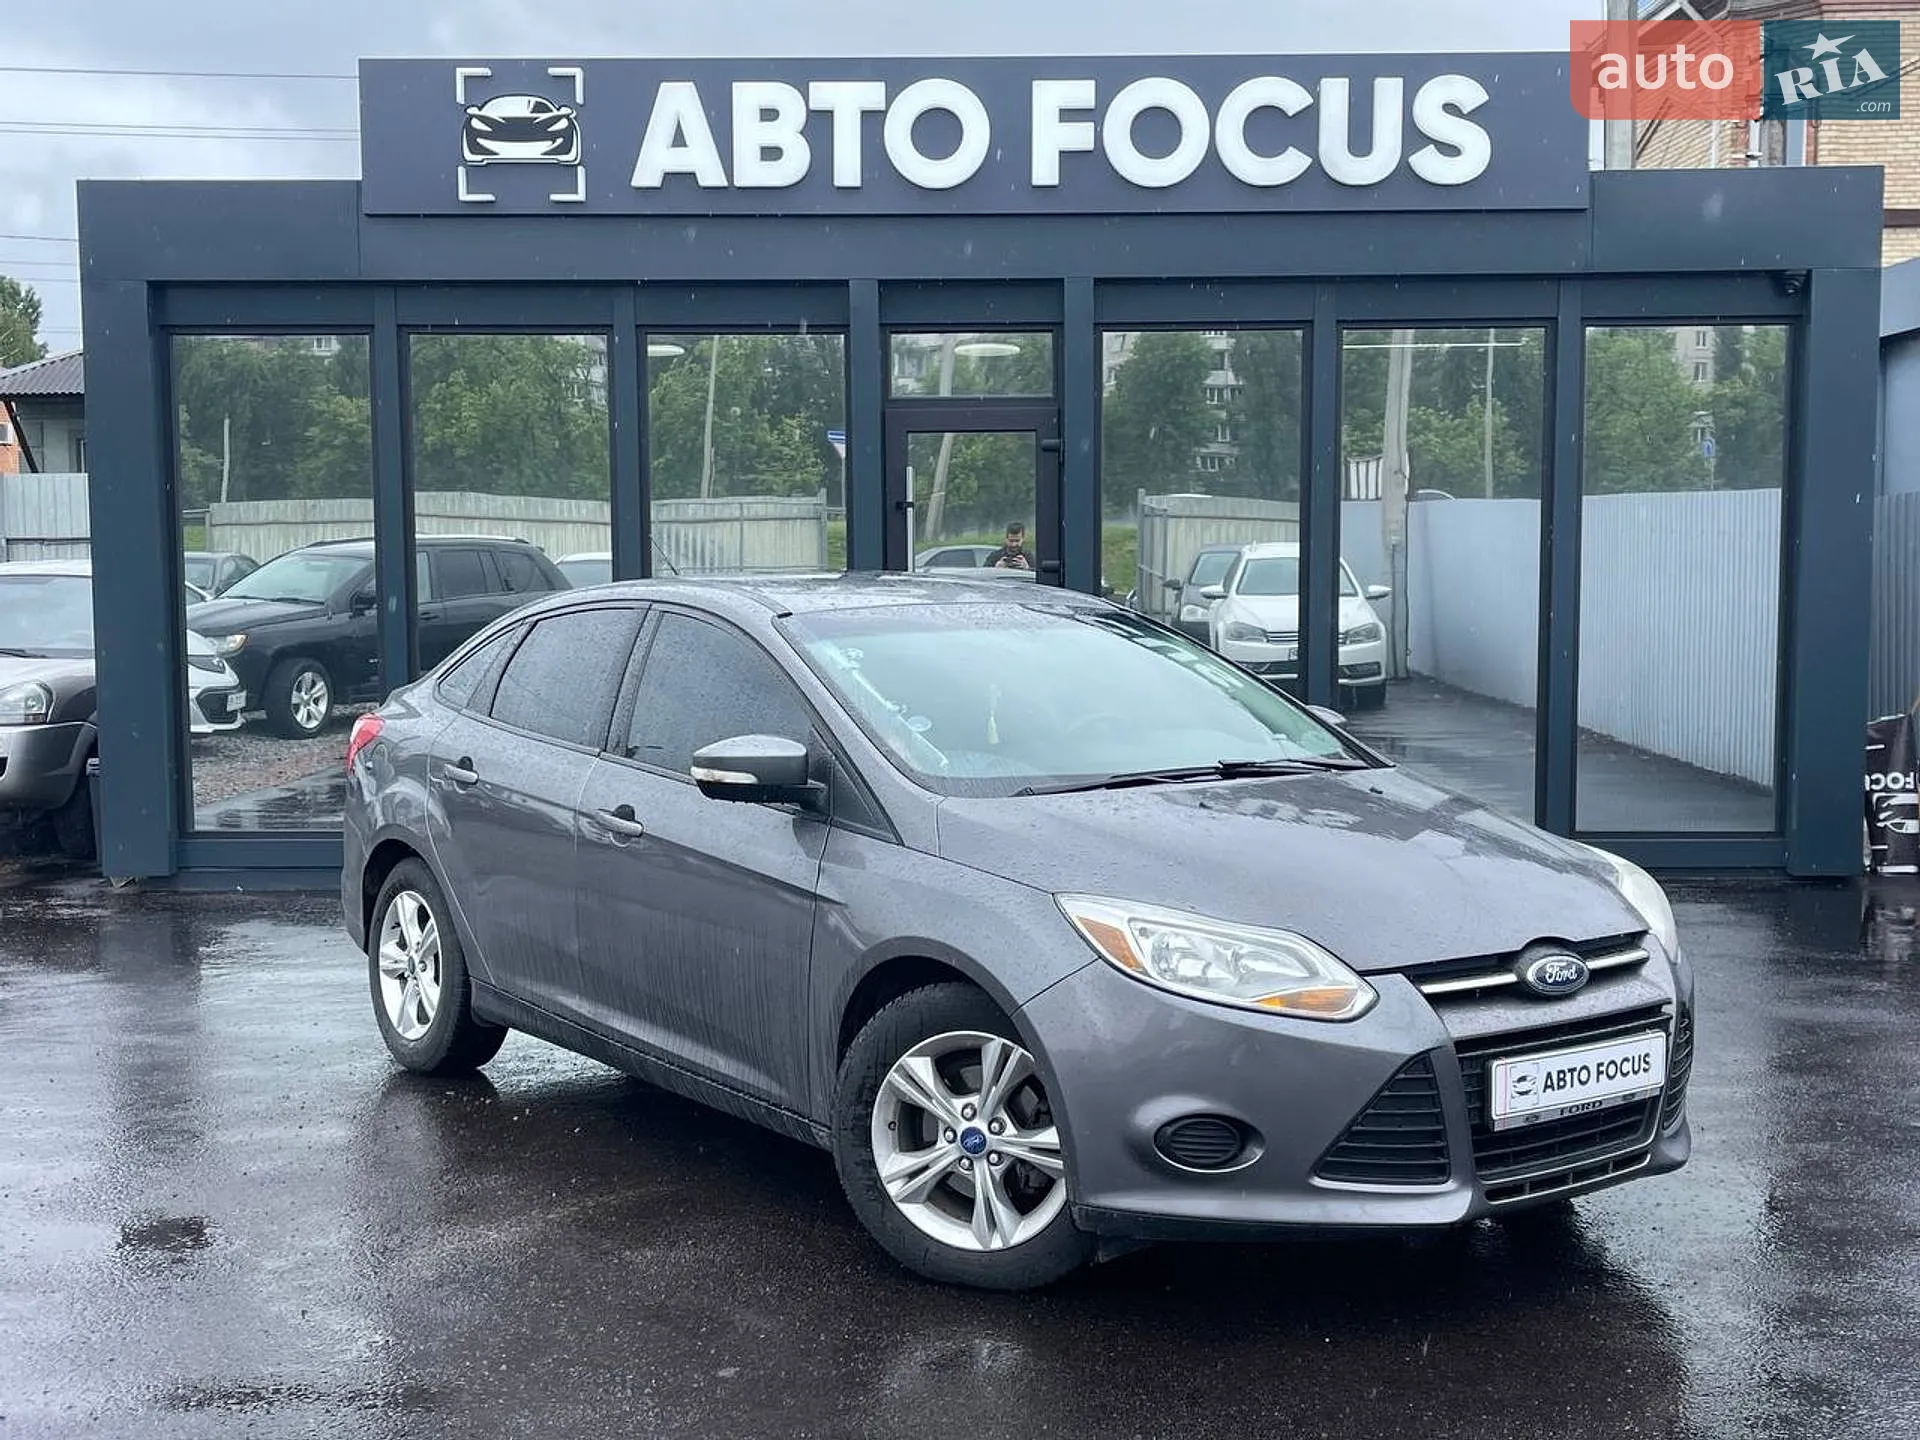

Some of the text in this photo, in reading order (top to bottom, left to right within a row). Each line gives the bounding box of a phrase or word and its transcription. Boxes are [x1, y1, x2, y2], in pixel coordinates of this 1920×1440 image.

[631, 73, 1493, 190] АВТО FOCUS
[1545, 962, 1578, 982] Ford
[1543, 1052, 1653, 1093] АВТО FOCUS
[1560, 1101, 1603, 1116] FORD
